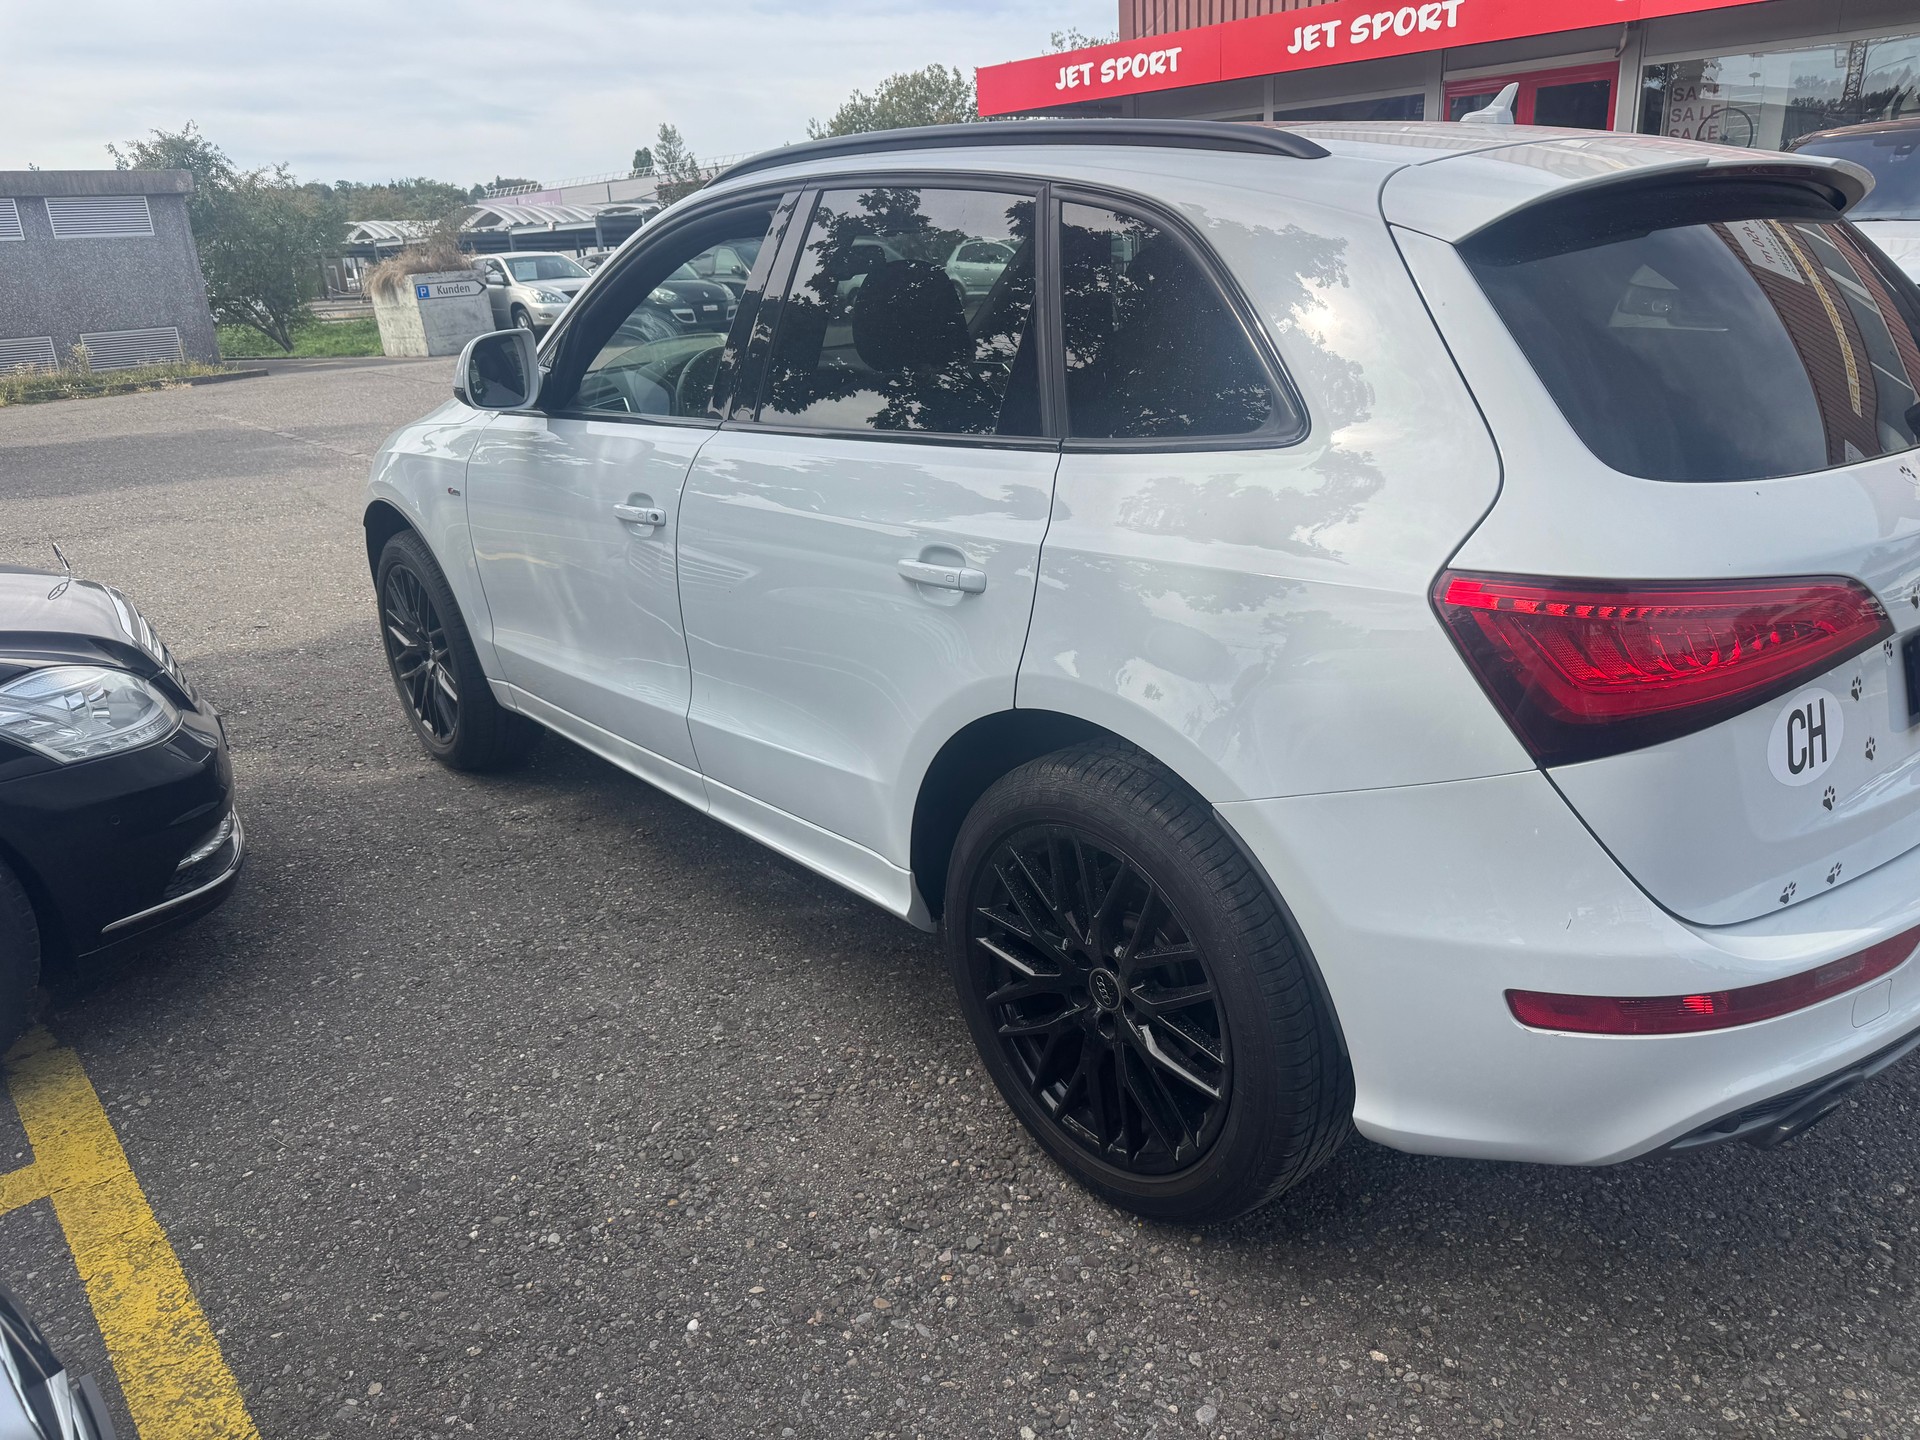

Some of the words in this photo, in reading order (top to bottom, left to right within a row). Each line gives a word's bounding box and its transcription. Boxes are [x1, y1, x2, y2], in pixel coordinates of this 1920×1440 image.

[1287, 20, 1342, 54] JET
[1350, 0, 1465, 44] SPORT
[1055, 62, 1094, 90] JET
[1101, 47, 1182, 83] SPORT
[1673, 84, 1720, 102] SA
[1671, 104, 1720, 122] SALE
[436, 284, 471, 295] Kunden
[1787, 697, 1828, 775] CH
